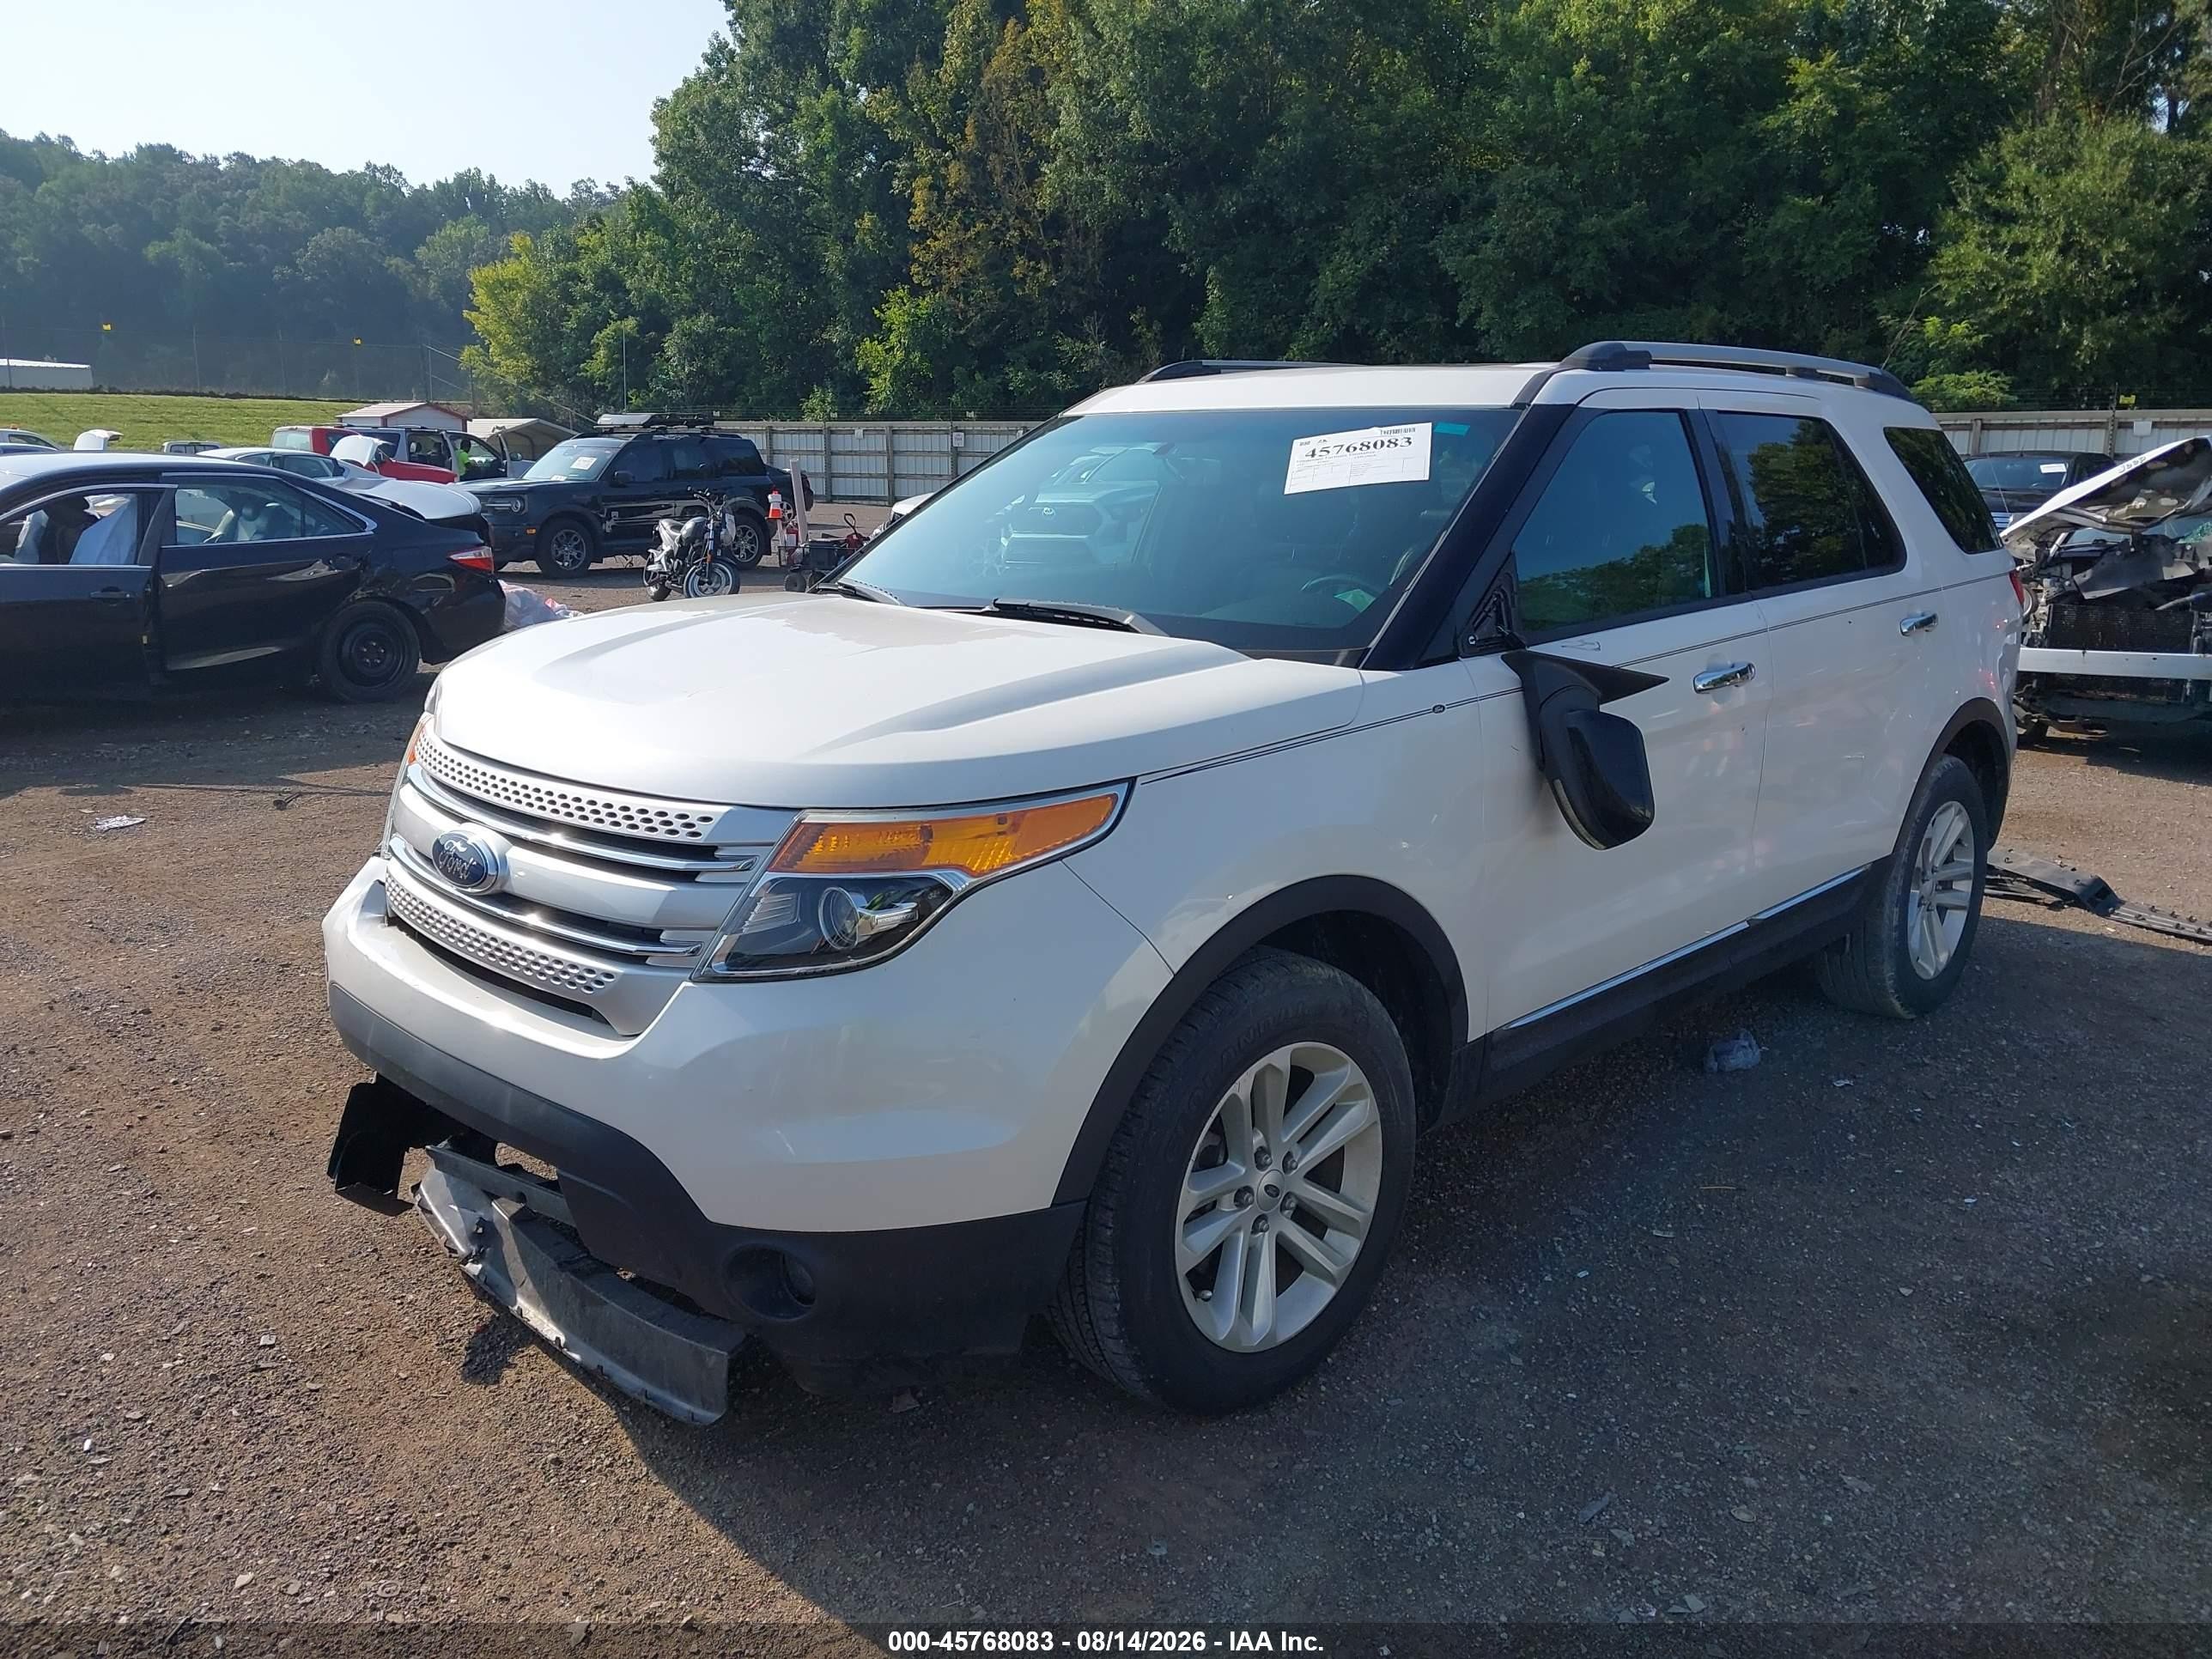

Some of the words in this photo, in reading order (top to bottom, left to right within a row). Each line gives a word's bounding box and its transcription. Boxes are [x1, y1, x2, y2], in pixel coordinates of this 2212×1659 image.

[1304, 436, 1413, 459] 45768083
[2118, 456, 2147, 473] Jeep
[439, 839, 477, 880] Ford
